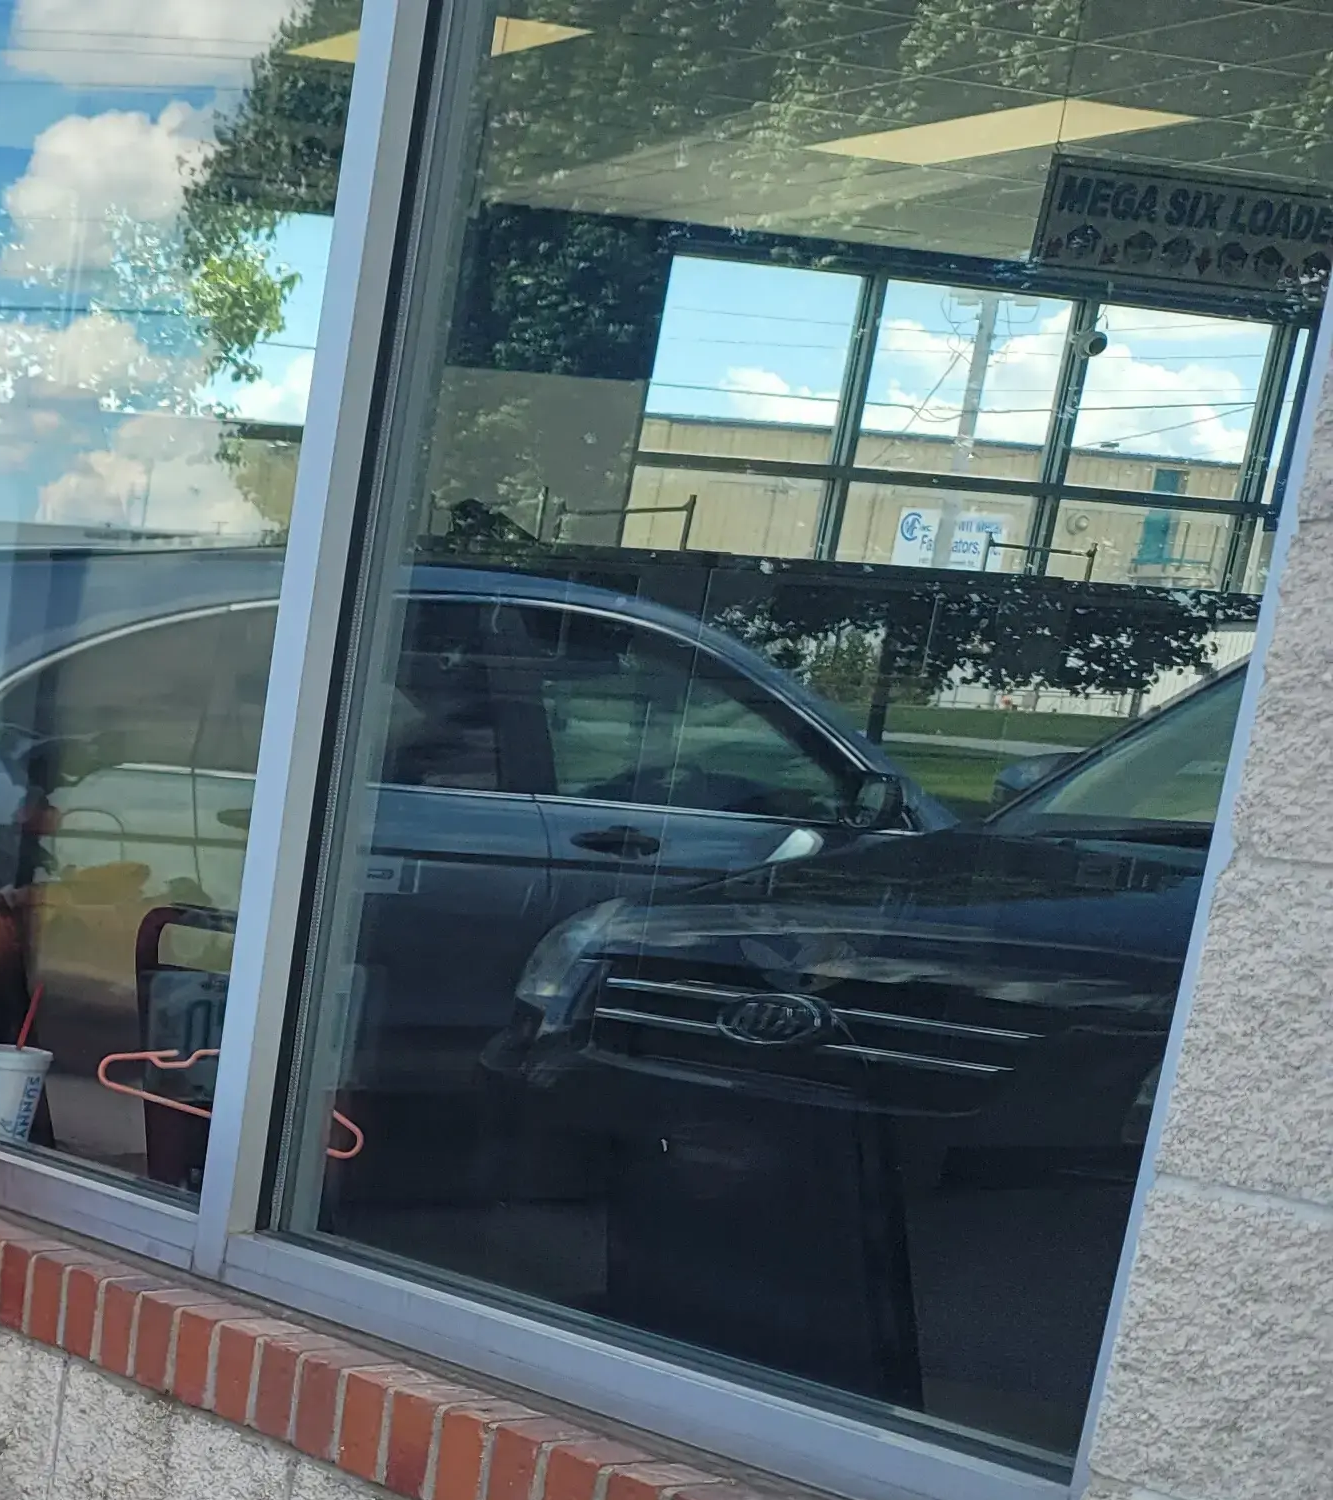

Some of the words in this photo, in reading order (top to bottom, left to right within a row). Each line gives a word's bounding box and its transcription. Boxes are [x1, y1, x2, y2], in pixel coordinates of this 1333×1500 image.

[1057, 175, 1157, 222] MEGA
[1165, 188, 1227, 229] SIX
[15, 1076, 41, 1138] SUNNY
